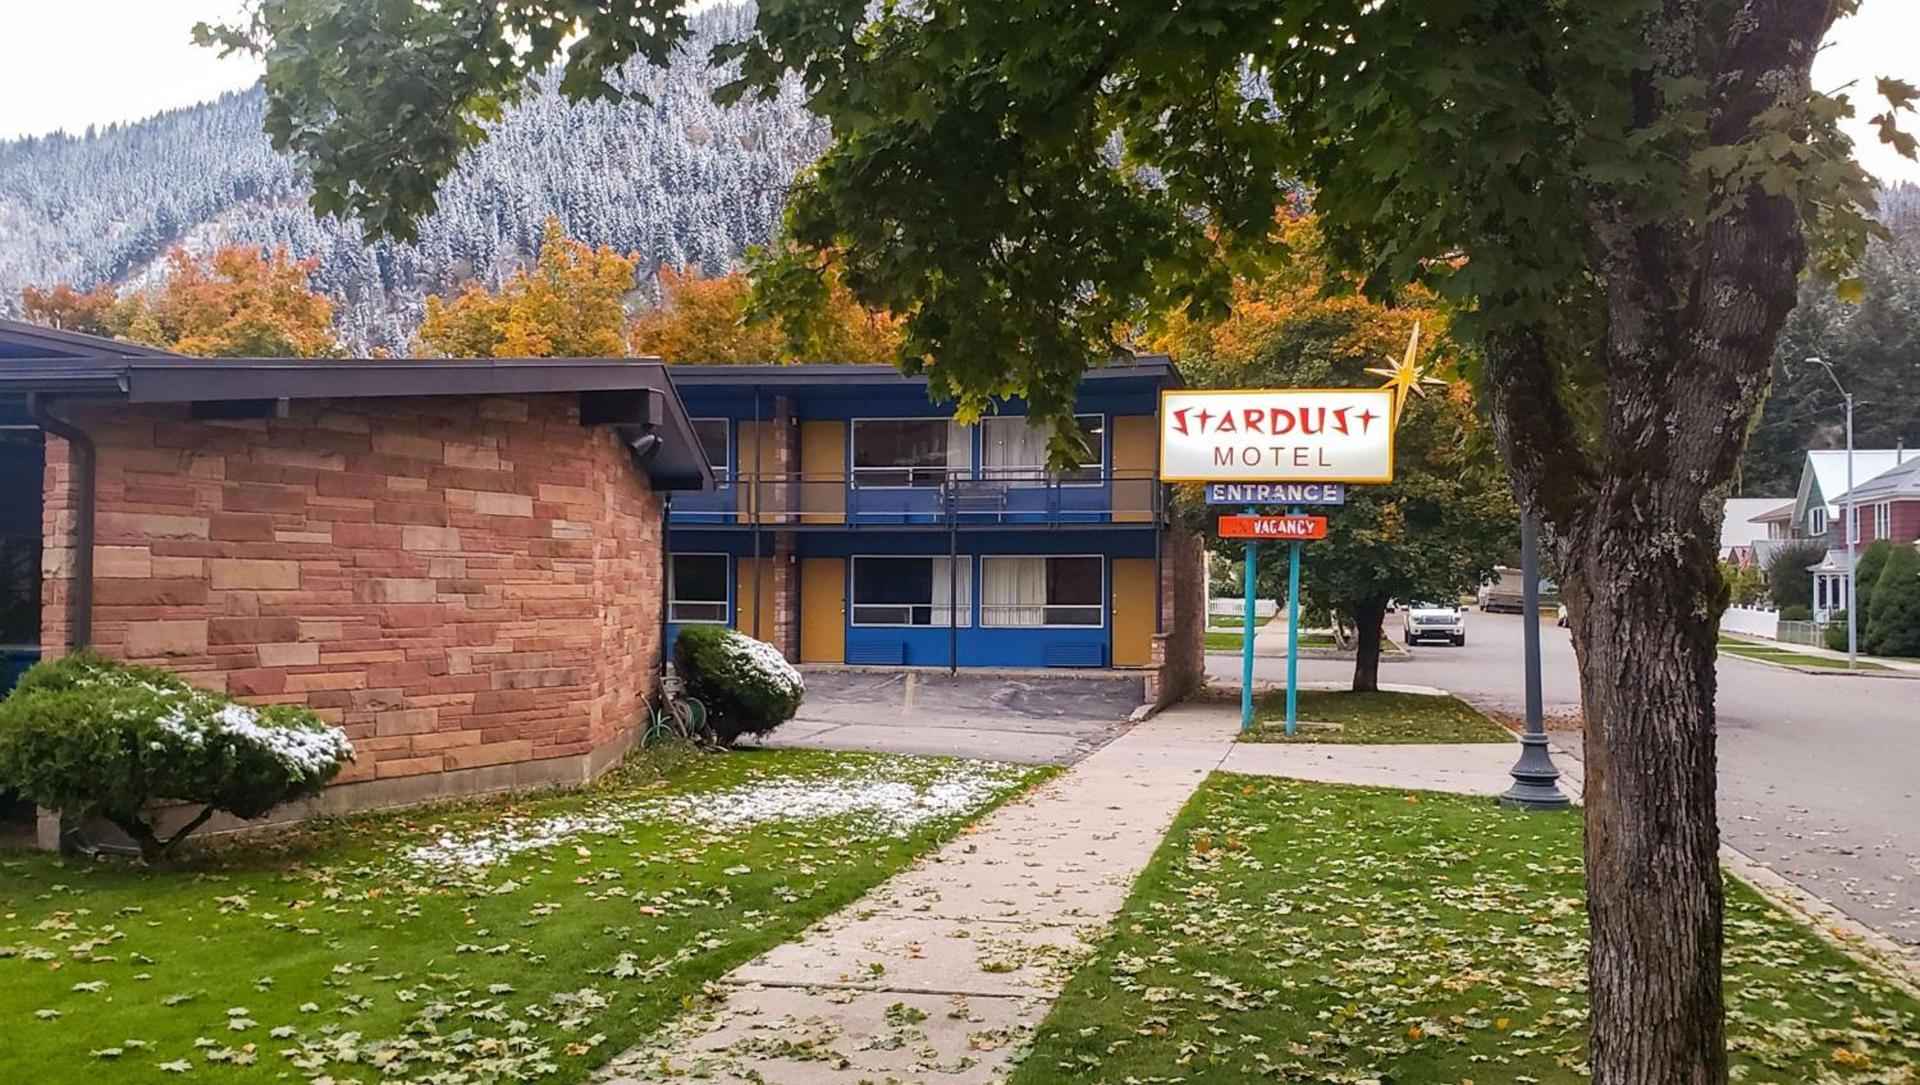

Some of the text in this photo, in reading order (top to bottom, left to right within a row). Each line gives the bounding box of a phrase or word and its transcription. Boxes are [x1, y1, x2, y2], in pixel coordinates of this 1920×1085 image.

[1171, 406, 1380, 436] STARDUST
[1214, 447, 1332, 467] MOTEL
[1213, 484, 1337, 501] ENTRANCE
[1254, 519, 1315, 535] VACANCY
